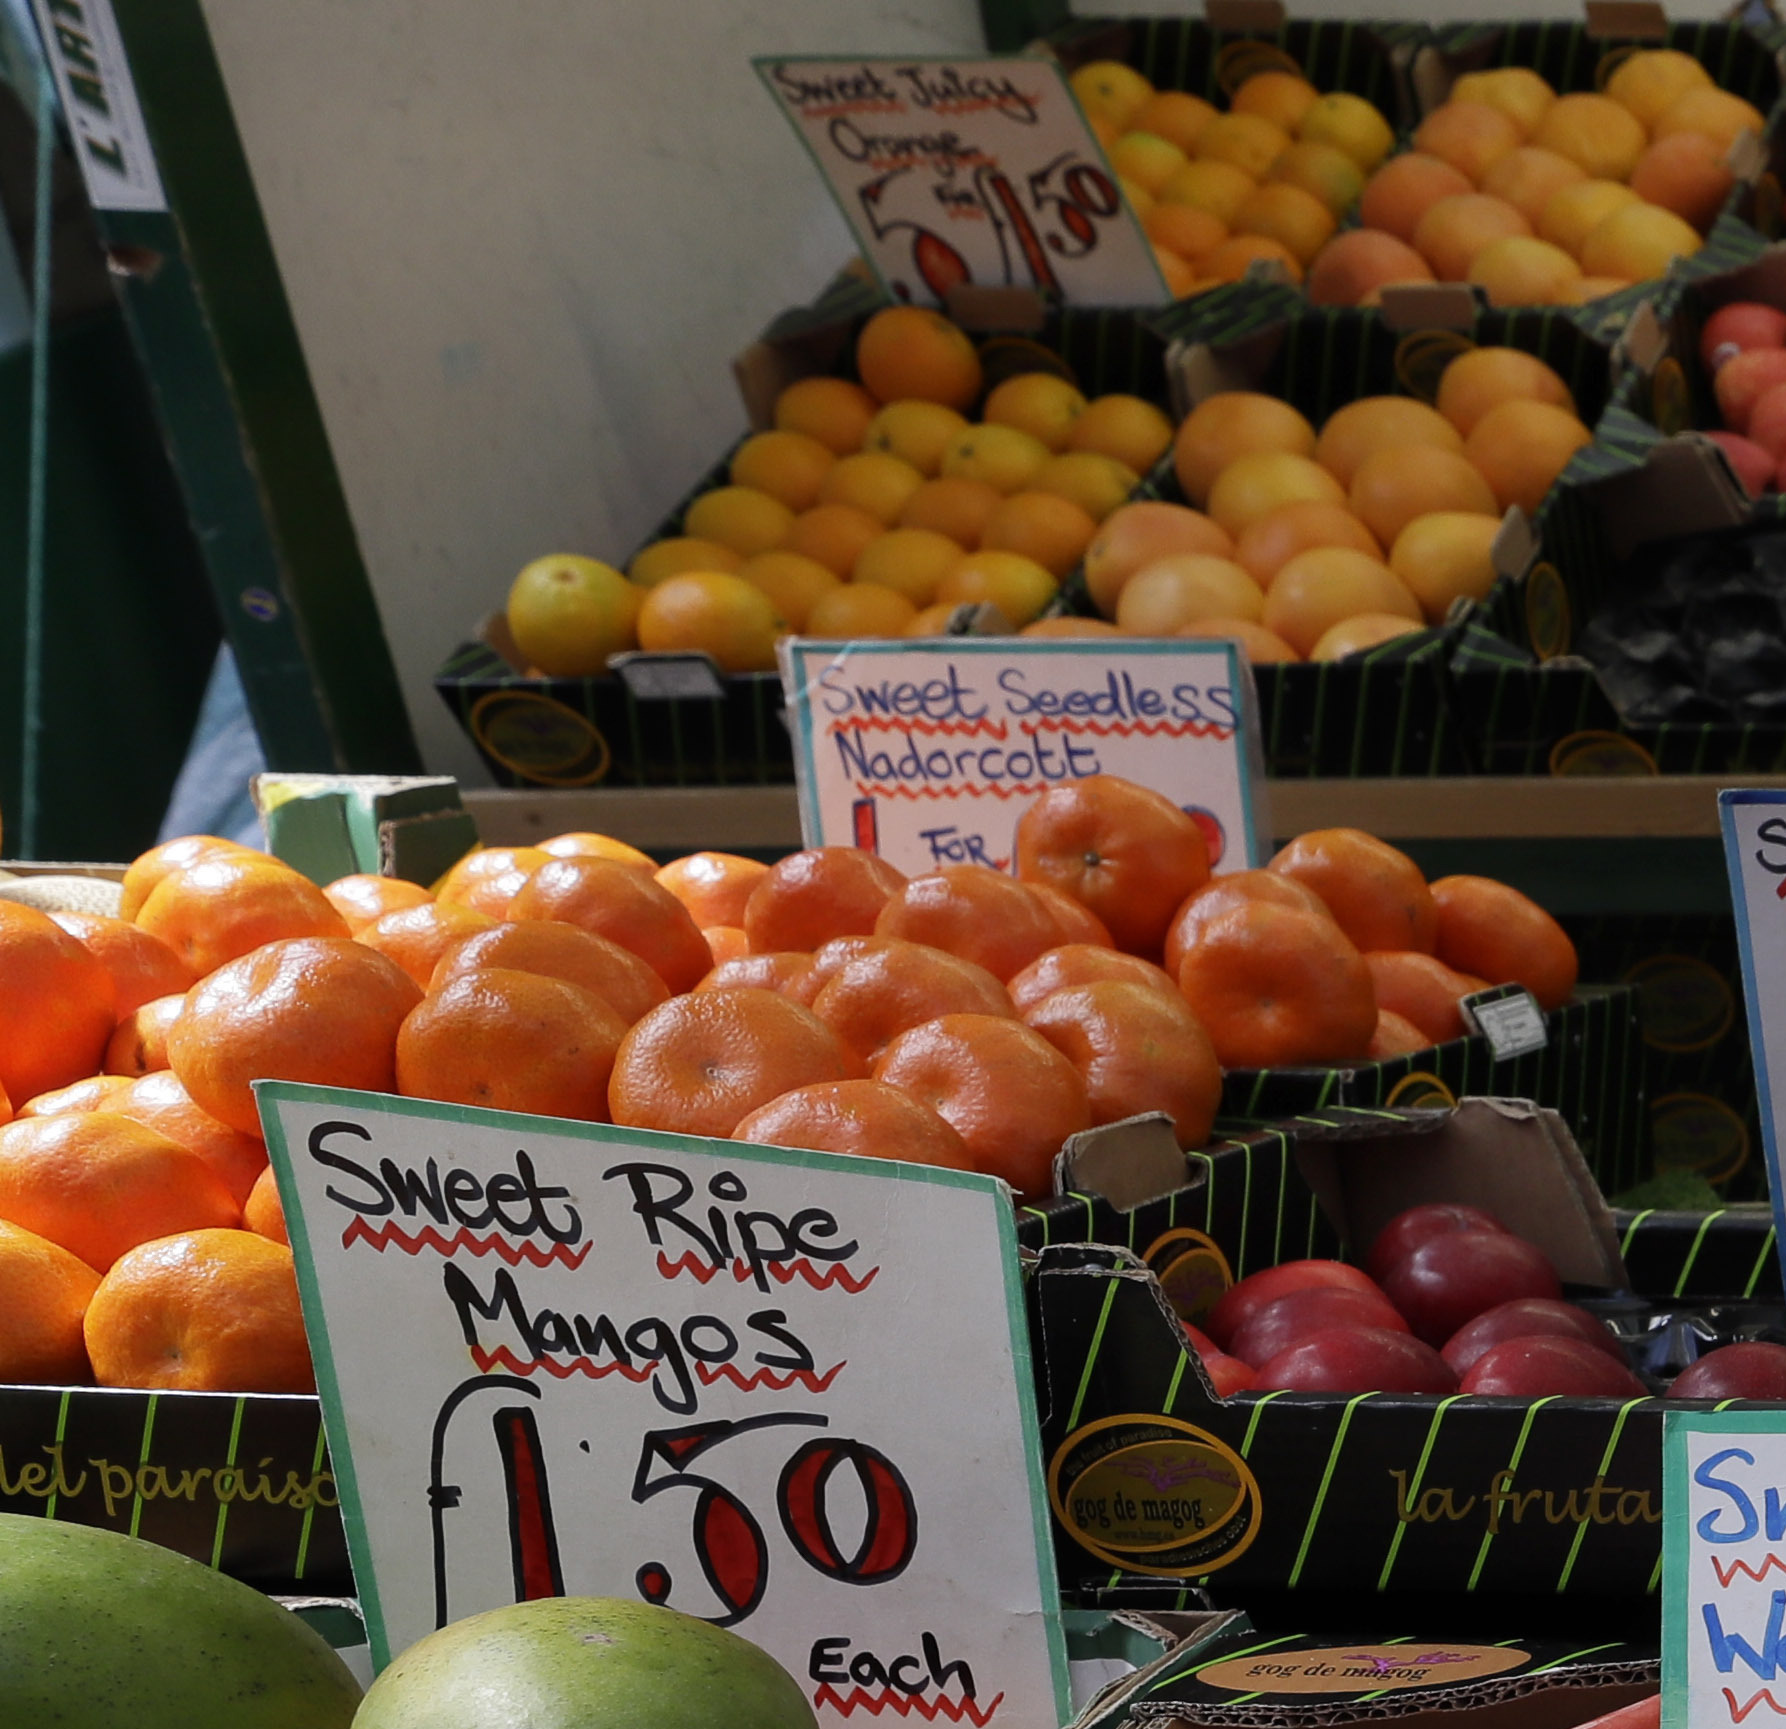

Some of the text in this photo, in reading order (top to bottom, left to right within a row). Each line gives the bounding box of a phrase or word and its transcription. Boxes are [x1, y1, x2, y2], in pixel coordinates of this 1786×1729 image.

[775, 66, 1038, 124] Sweet Juicy
[819, 664, 1242, 731] Sweet Seedless
[834, 728, 1102, 782] Nadorcott
[308, 1120, 861, 1293] Sweet Ripe
[442, 1261, 817, 1415] Mangos
[1114, 1490, 1136, 1521] de
[1388, 1467, 1663, 1535] la fruta
[809, 1632, 975, 1702] Each
[1246, 1662, 1432, 1681] gog de magog
